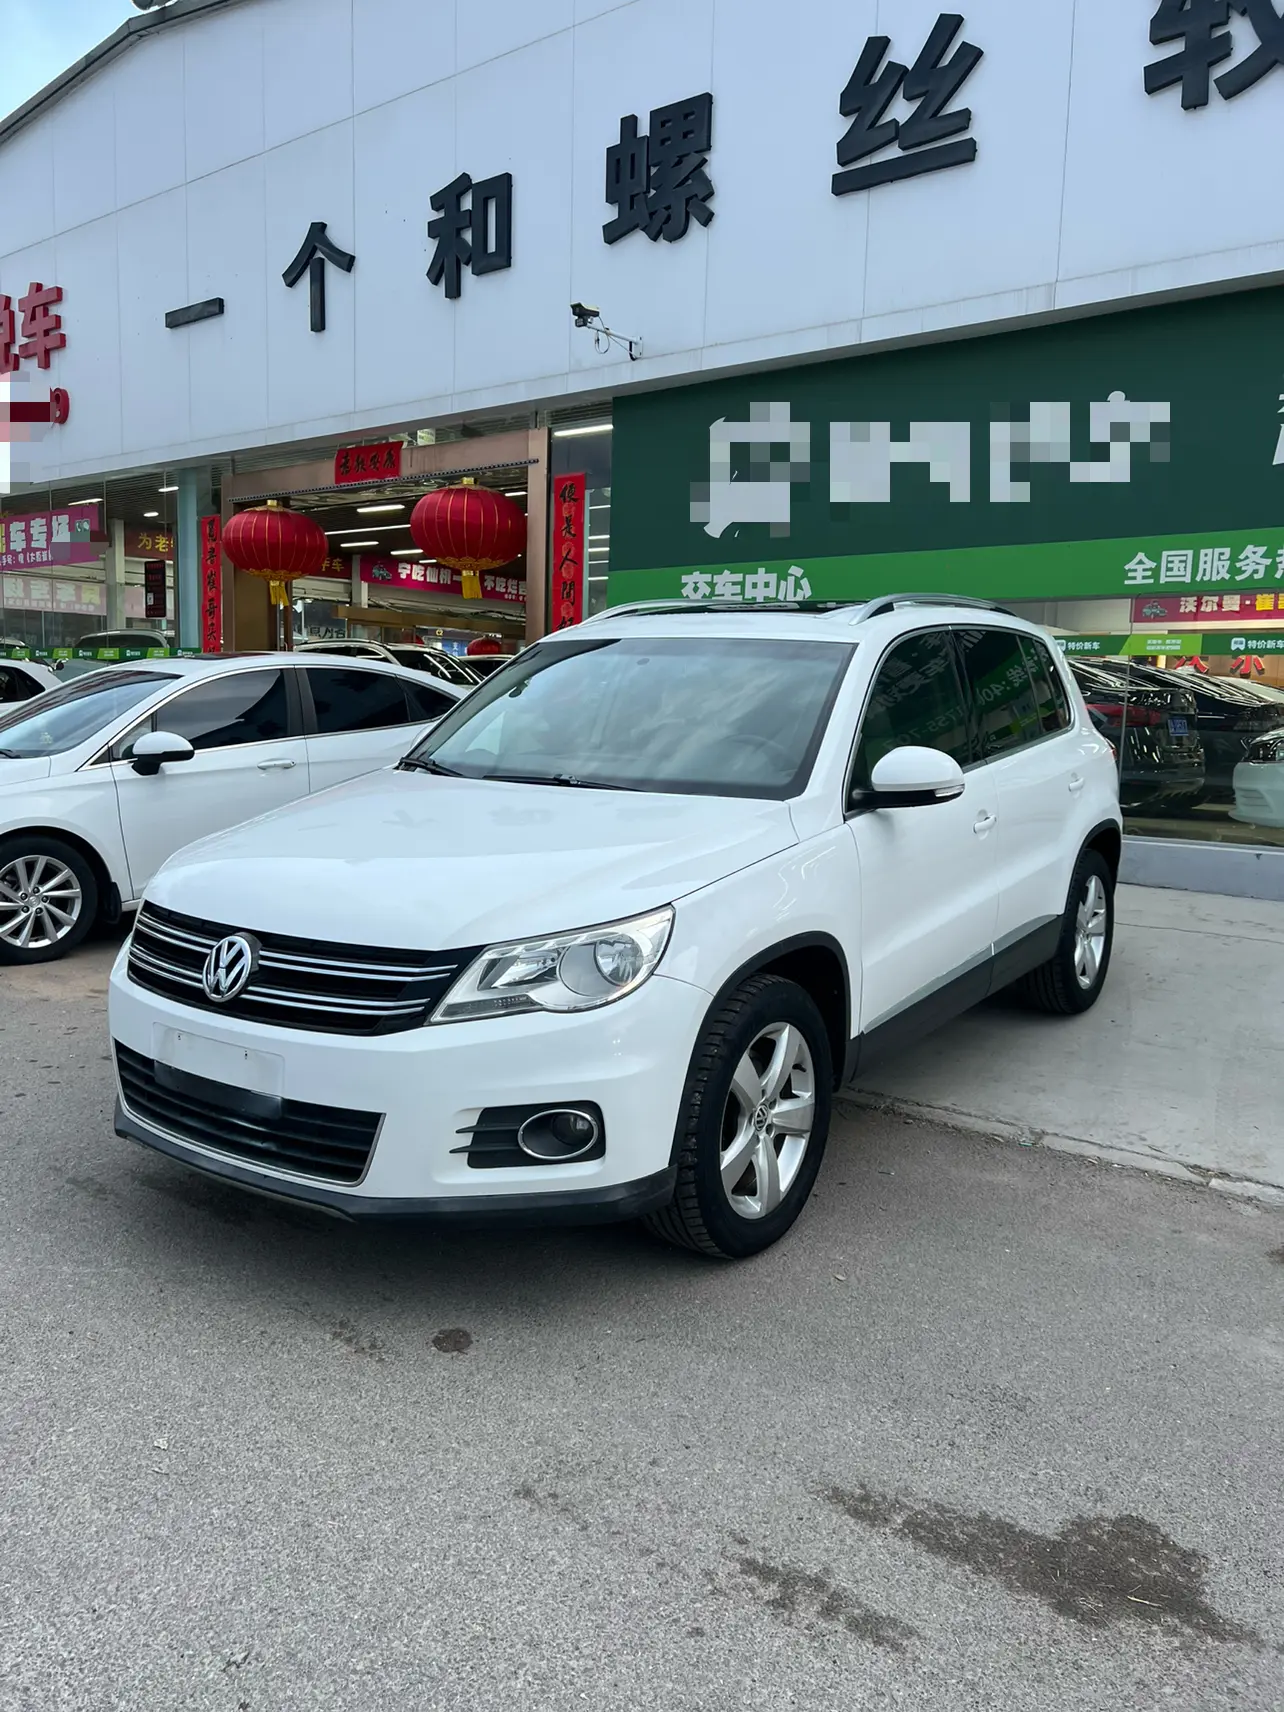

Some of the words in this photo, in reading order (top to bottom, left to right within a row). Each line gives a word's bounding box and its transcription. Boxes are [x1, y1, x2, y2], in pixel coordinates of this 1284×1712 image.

[681, 565, 812, 602] 交车中心
[1067, 641, 1101, 651] 特价新车
